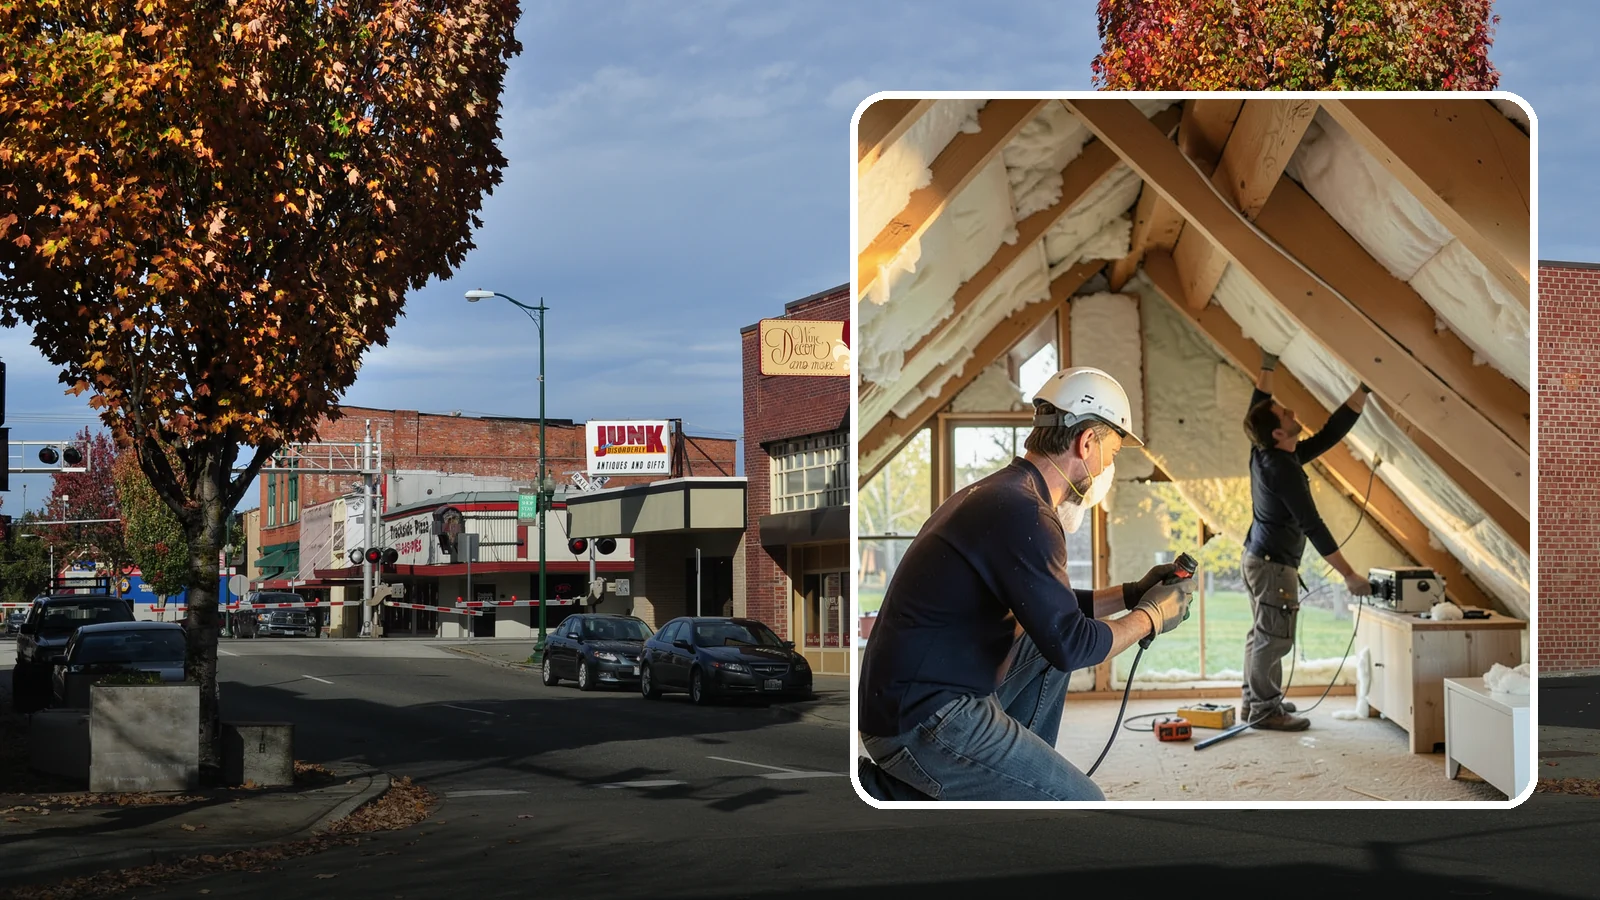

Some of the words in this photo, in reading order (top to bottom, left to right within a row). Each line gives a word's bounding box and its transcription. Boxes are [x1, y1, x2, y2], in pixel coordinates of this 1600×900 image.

[595, 425, 665, 457] JUNK
[607, 446, 646, 455] DISORDERLY
[596, 461, 628, 470] ANTIQUES
[631, 461, 644, 470] AND
[646, 460, 666, 469] GIFTS
[414, 519, 429, 535] Pizza
